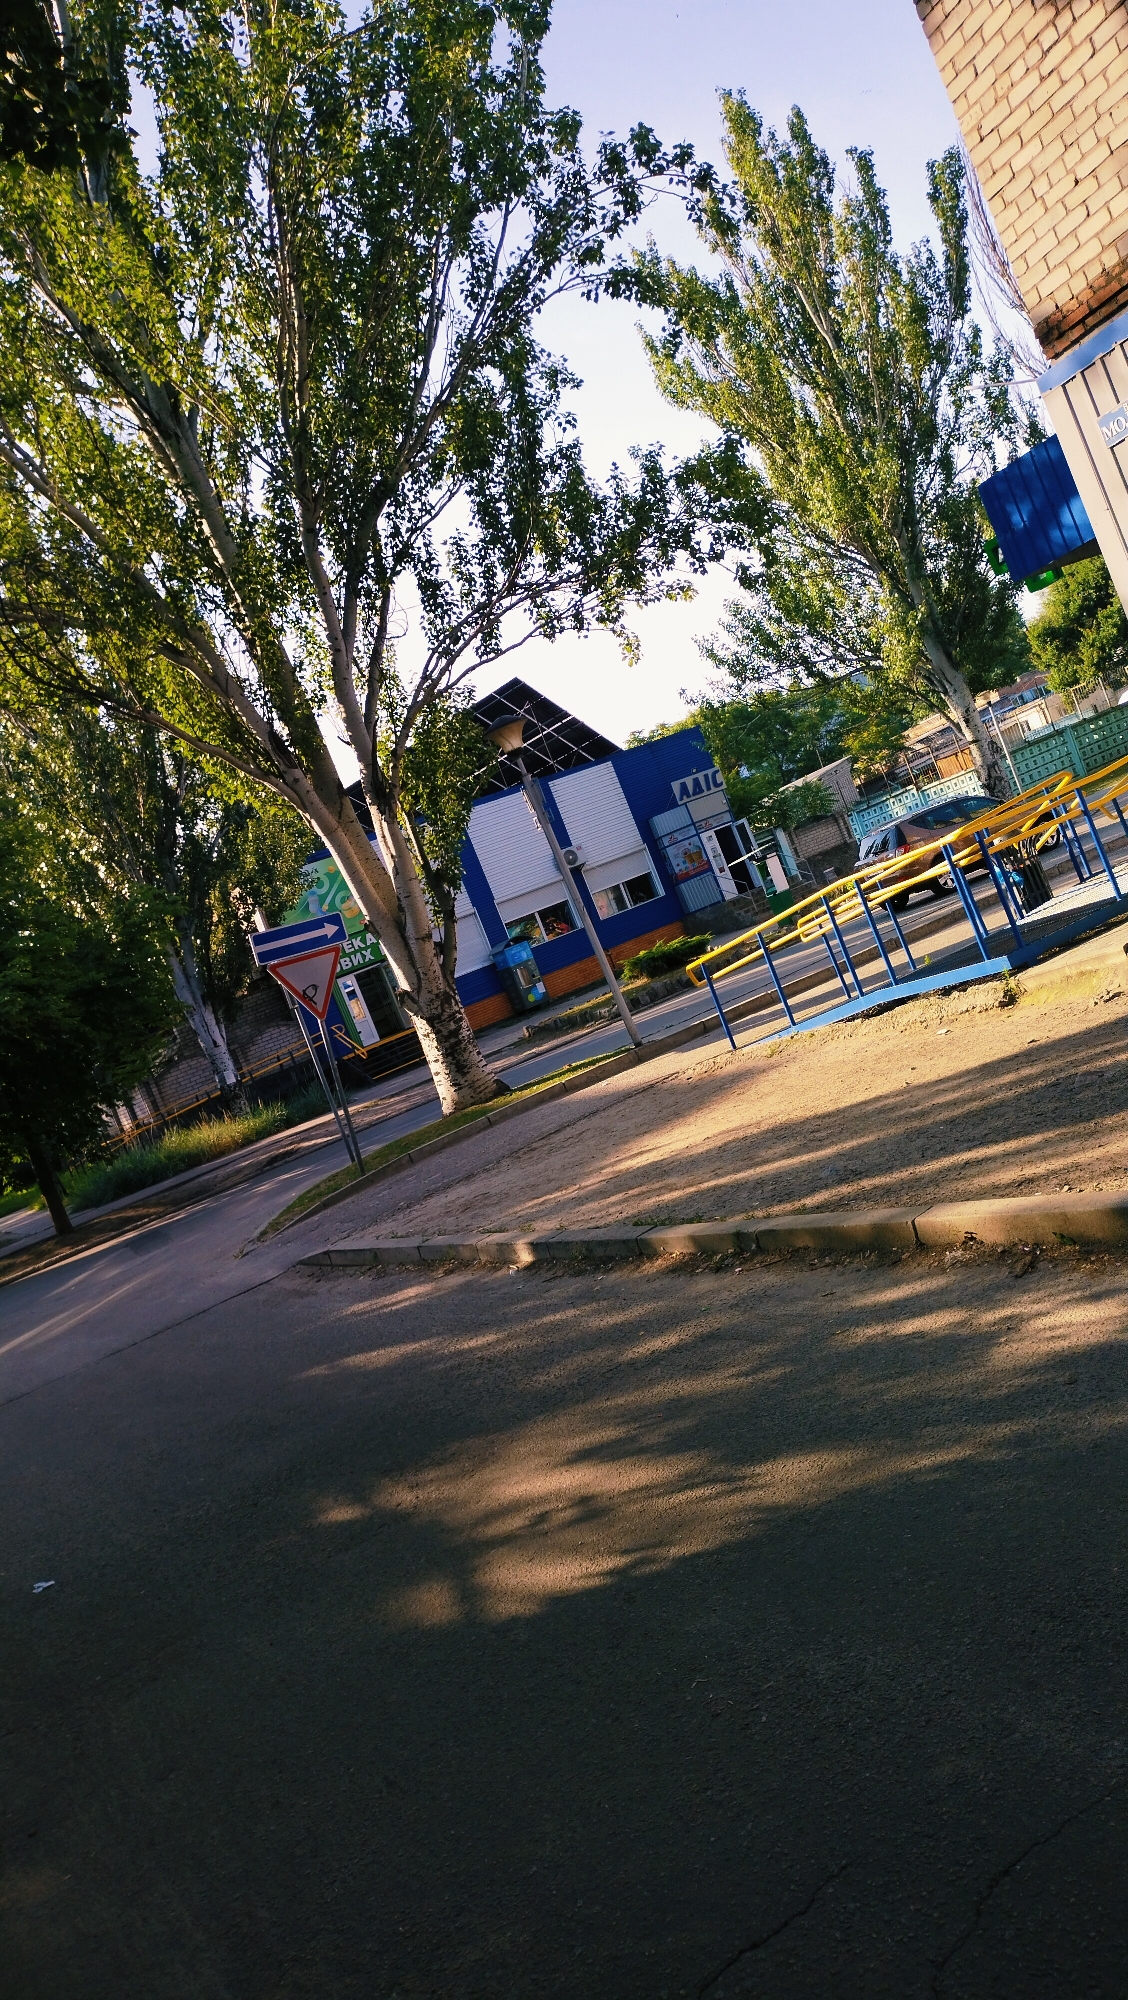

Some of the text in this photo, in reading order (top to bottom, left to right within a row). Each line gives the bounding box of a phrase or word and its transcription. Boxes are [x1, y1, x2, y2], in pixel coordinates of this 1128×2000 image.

[1101, 416, 1128, 441] МО
[679, 769, 724, 802] АДІС
[340, 932, 378, 956] ЕКА
[336, 948, 375, 973] ВИХ
